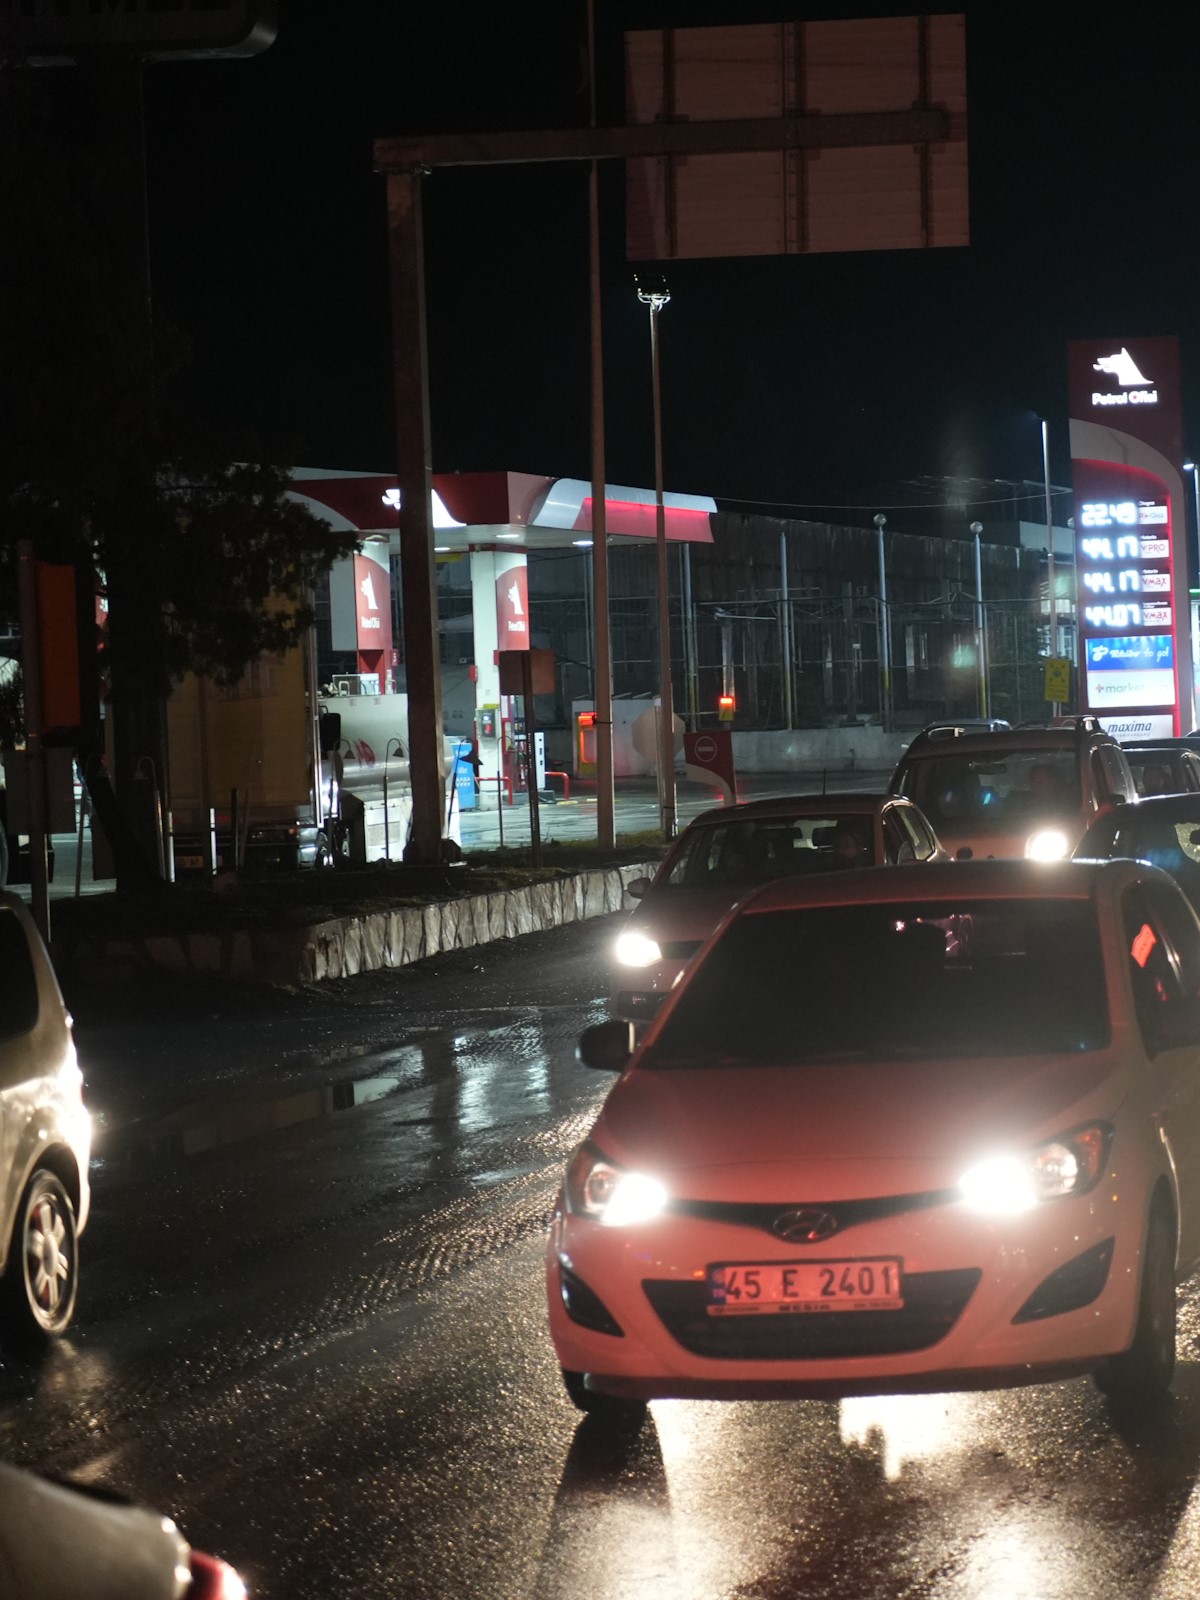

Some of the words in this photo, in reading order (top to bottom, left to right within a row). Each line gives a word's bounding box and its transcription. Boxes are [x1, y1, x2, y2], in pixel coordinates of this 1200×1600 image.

[1092, 392, 1128, 405] Petrol
[1128, 390, 1158, 404] Ofisi
[1144, 647, 1154, 657] to
[1156, 646, 1170, 663] go!
[1108, 721, 1152, 733] maxima
[726, 1270, 762, 1300] 45
[782, 1269, 799, 1298] E
[819, 1266, 891, 1296] 2401
